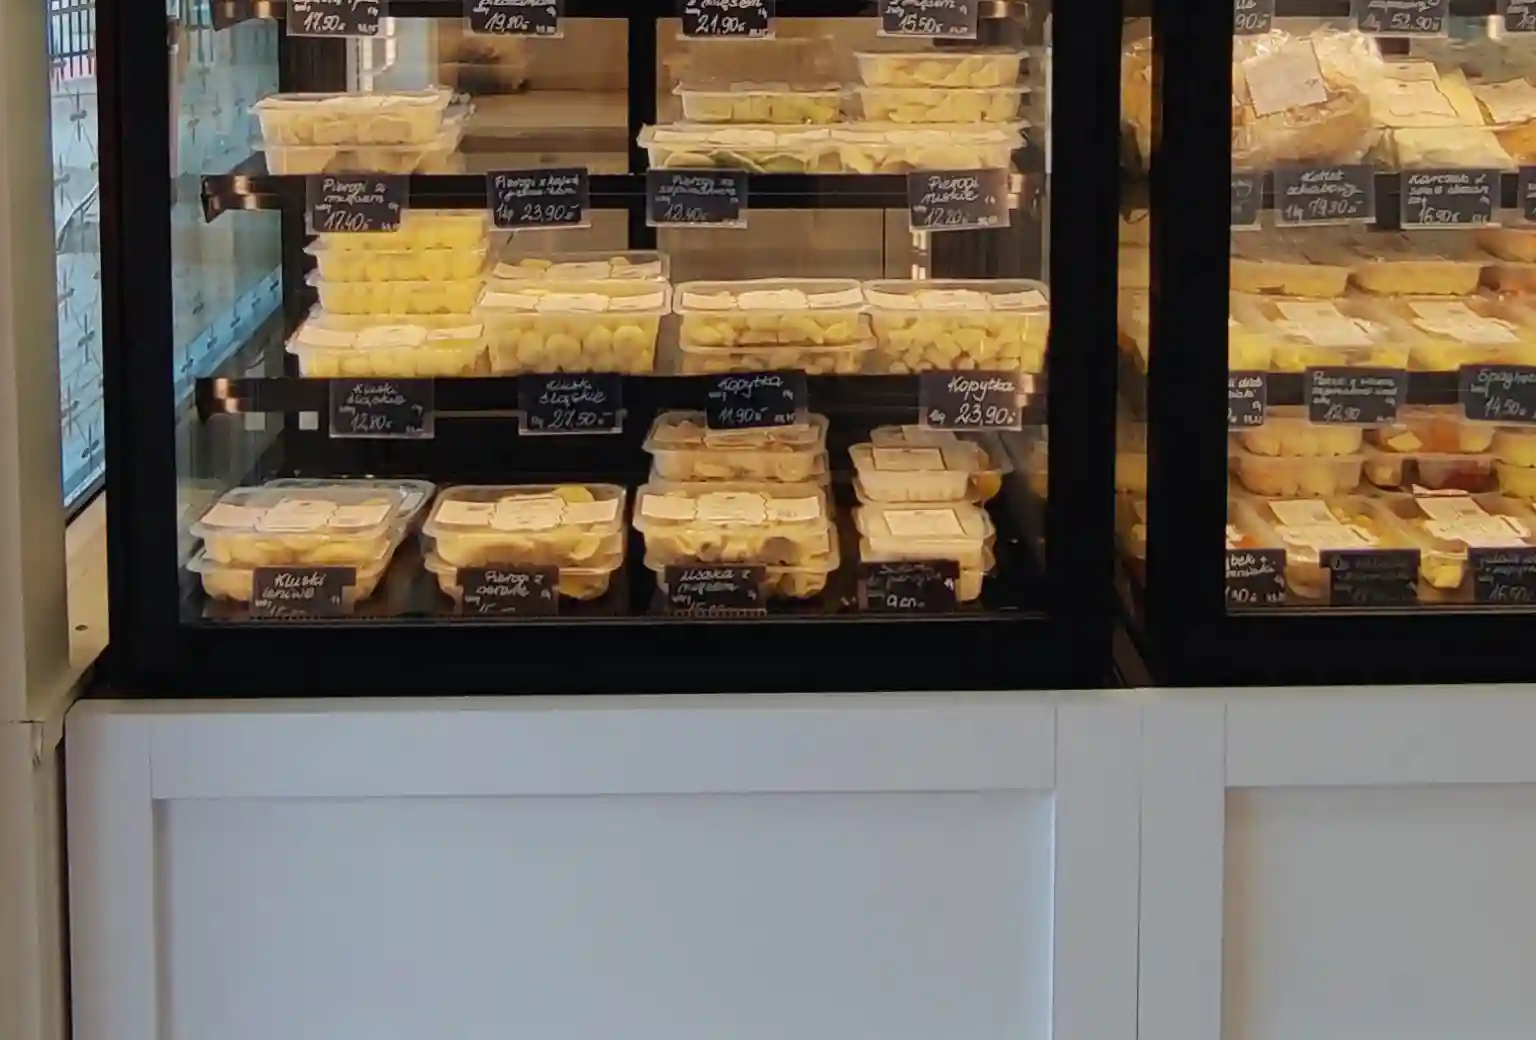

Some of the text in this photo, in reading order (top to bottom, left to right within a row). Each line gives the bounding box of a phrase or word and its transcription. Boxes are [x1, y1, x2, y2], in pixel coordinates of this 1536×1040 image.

[323, 177, 369, 199] Pierogi
[928, 175, 979, 191] Pierogi
[947, 376, 1017, 401] Kopytka
[273, 571, 327, 589] Kluski
